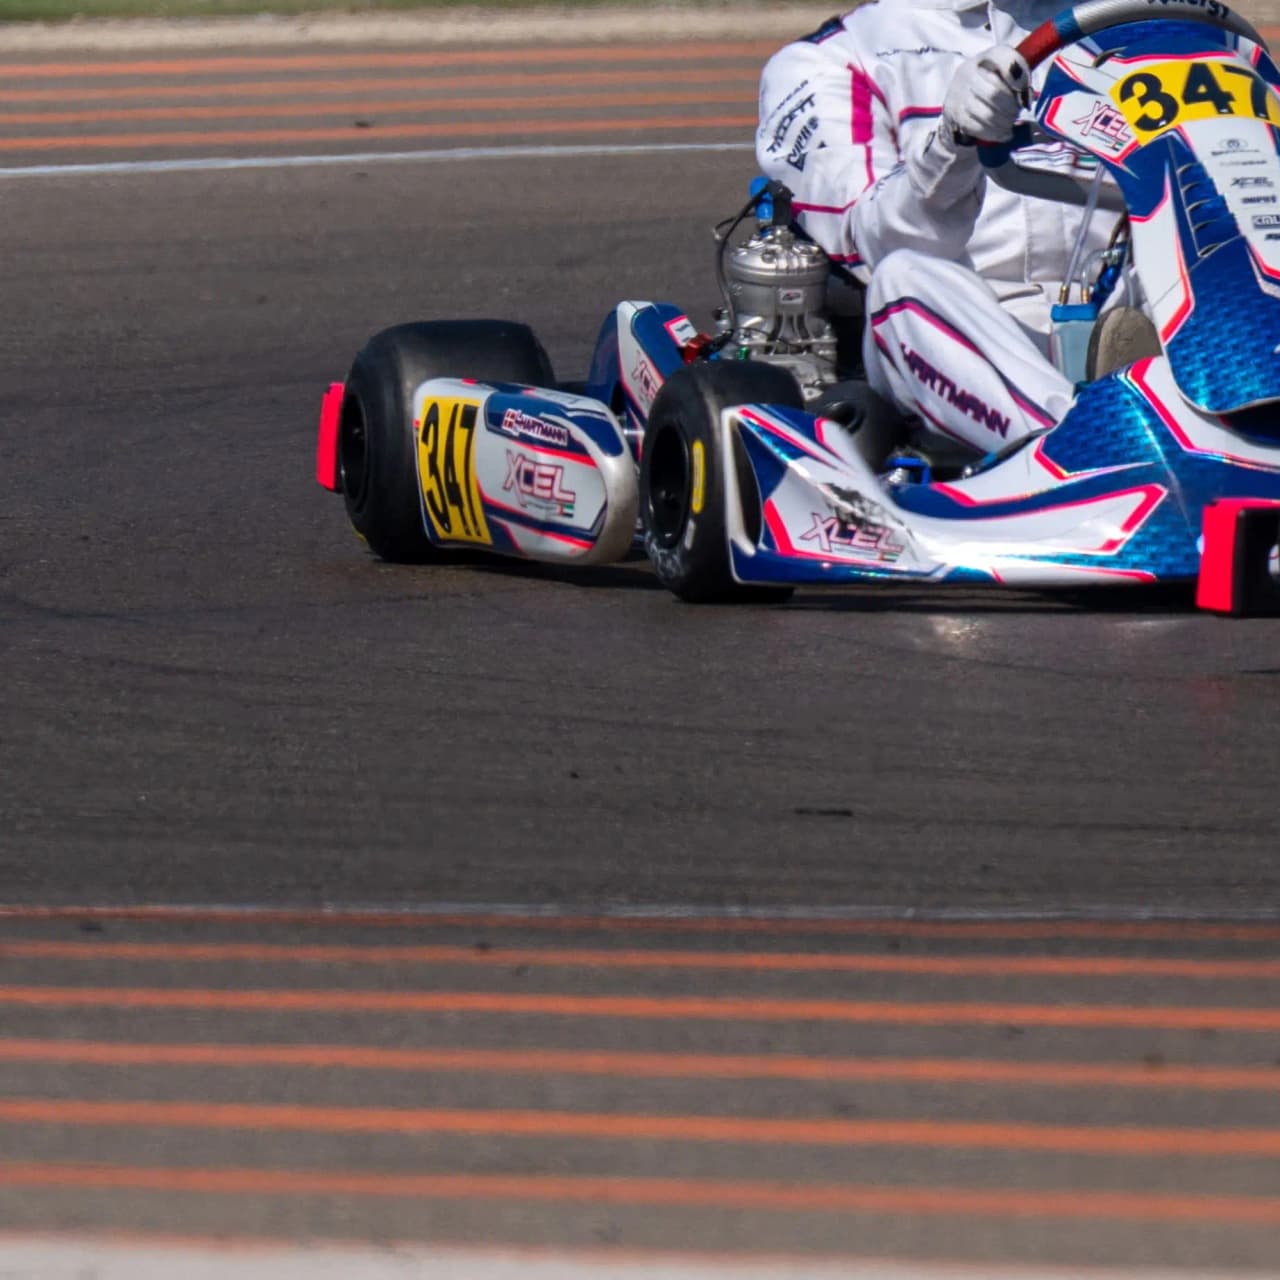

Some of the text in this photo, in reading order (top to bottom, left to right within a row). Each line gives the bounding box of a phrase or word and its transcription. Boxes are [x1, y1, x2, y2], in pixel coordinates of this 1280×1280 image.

[1072, 100, 1132, 142] XCEL
[1119, 62, 1270, 132] 347
[899, 341, 1011, 439] HARTMANN
[420, 401, 482, 537] 347
[502, 449, 577, 510] XCEL
